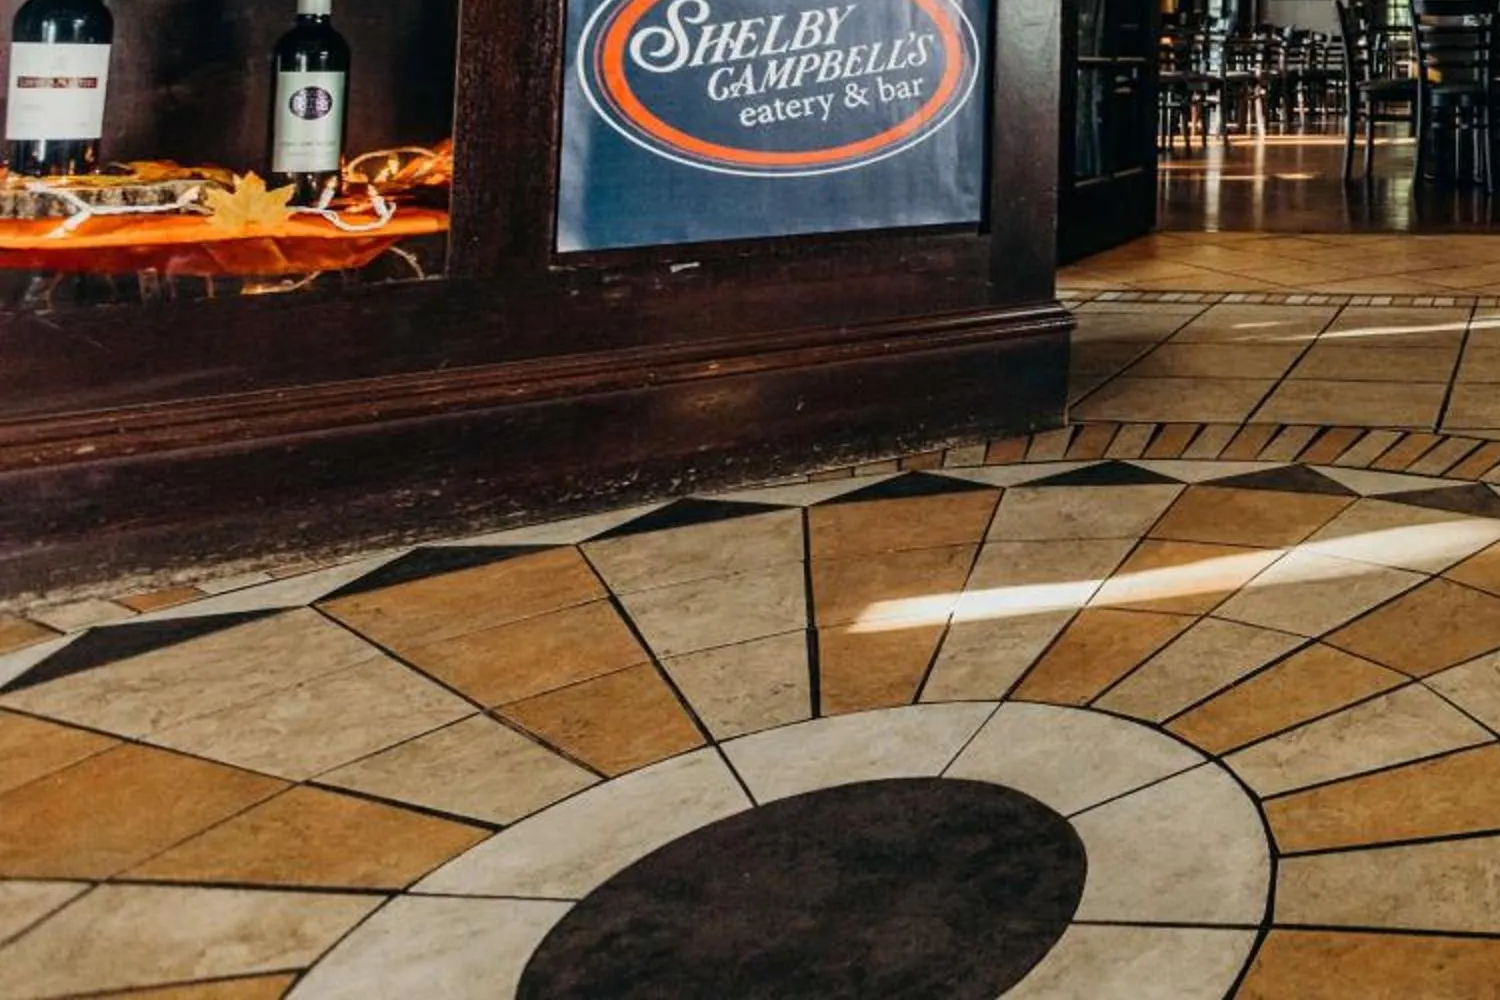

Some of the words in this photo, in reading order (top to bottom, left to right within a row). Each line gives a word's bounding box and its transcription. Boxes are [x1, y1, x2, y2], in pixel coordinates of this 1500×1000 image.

[707, 31, 935, 101] CAMPBELL'S
[739, 92, 835, 127] eatery
[843, 82, 870, 108] &
[875, 75, 924, 102] bar
